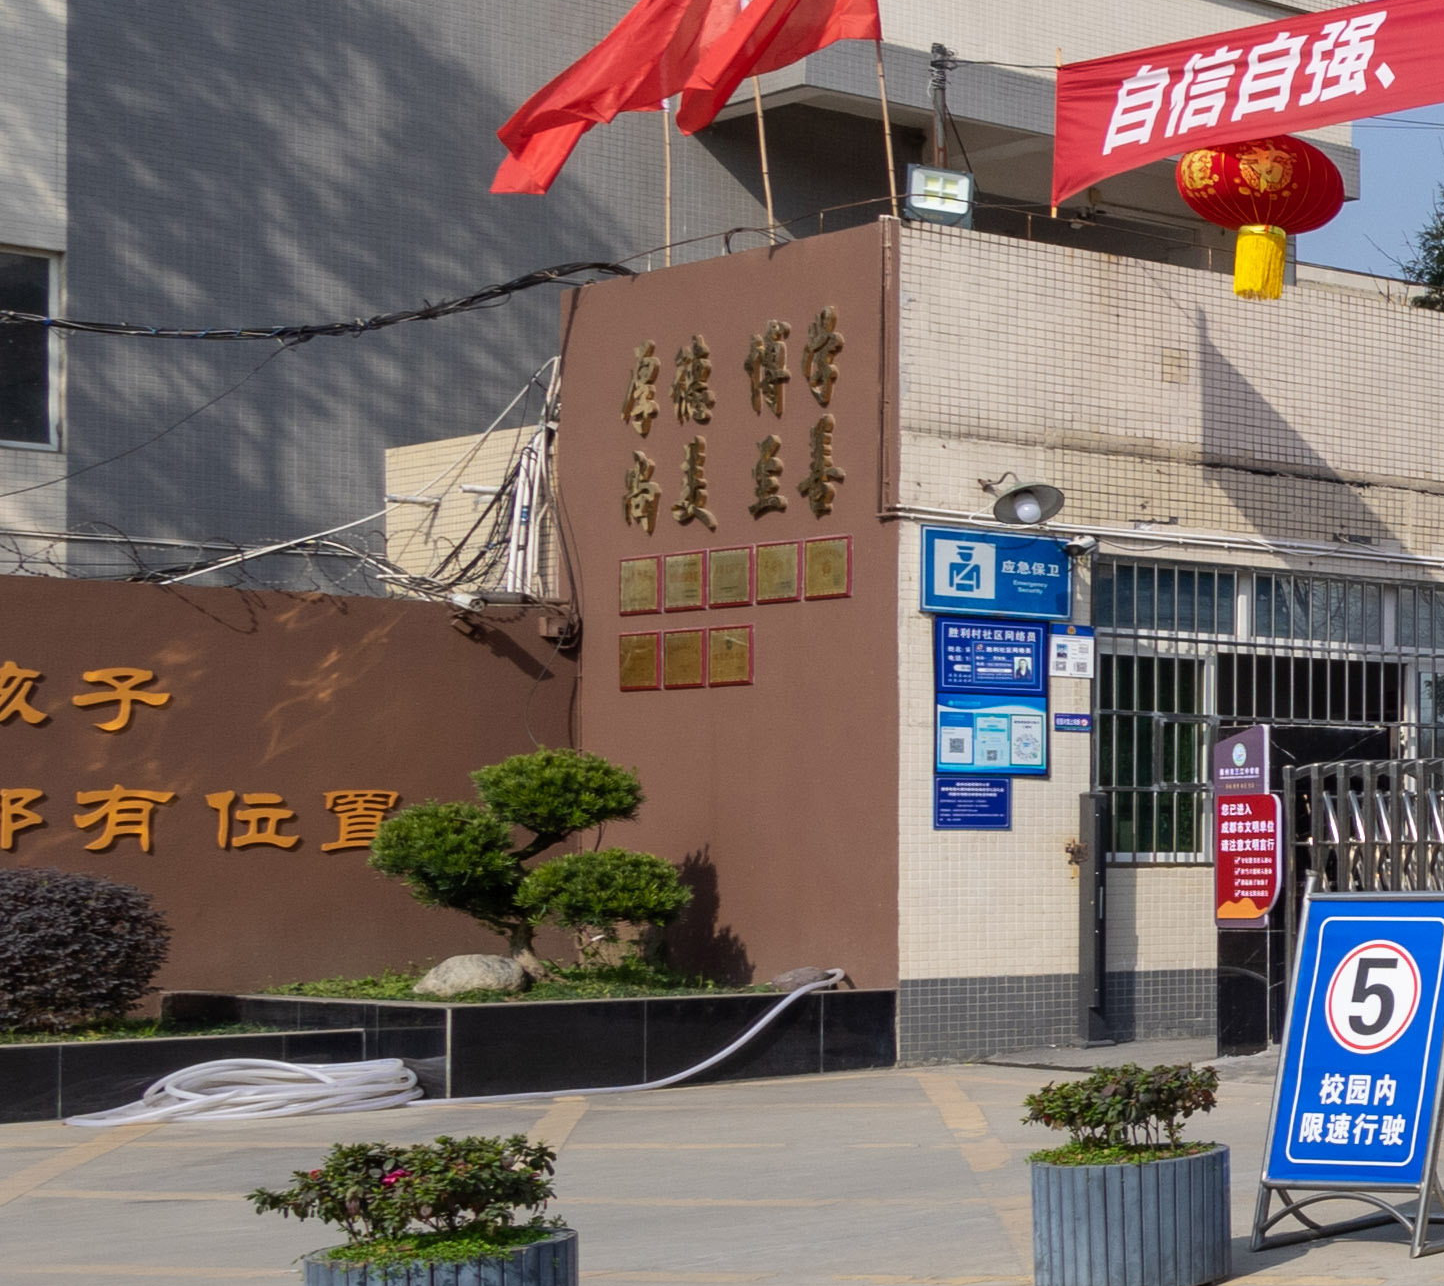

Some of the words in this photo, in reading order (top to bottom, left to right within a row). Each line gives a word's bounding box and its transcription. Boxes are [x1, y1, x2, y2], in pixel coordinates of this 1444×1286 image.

[621, 336, 716, 438] 厚德
[744, 305, 845, 419] 博学
[1001, 559, 1061, 578] 应急保卫
[1013, 579, 1048, 589] Emergency
[1221, 803, 1252, 816] 您已进入
[1348, 957, 1398, 1036] 5
[1319, 1072, 1397, 1106] 校园内
[1299, 1112, 1407, 1146] 限速行驶
